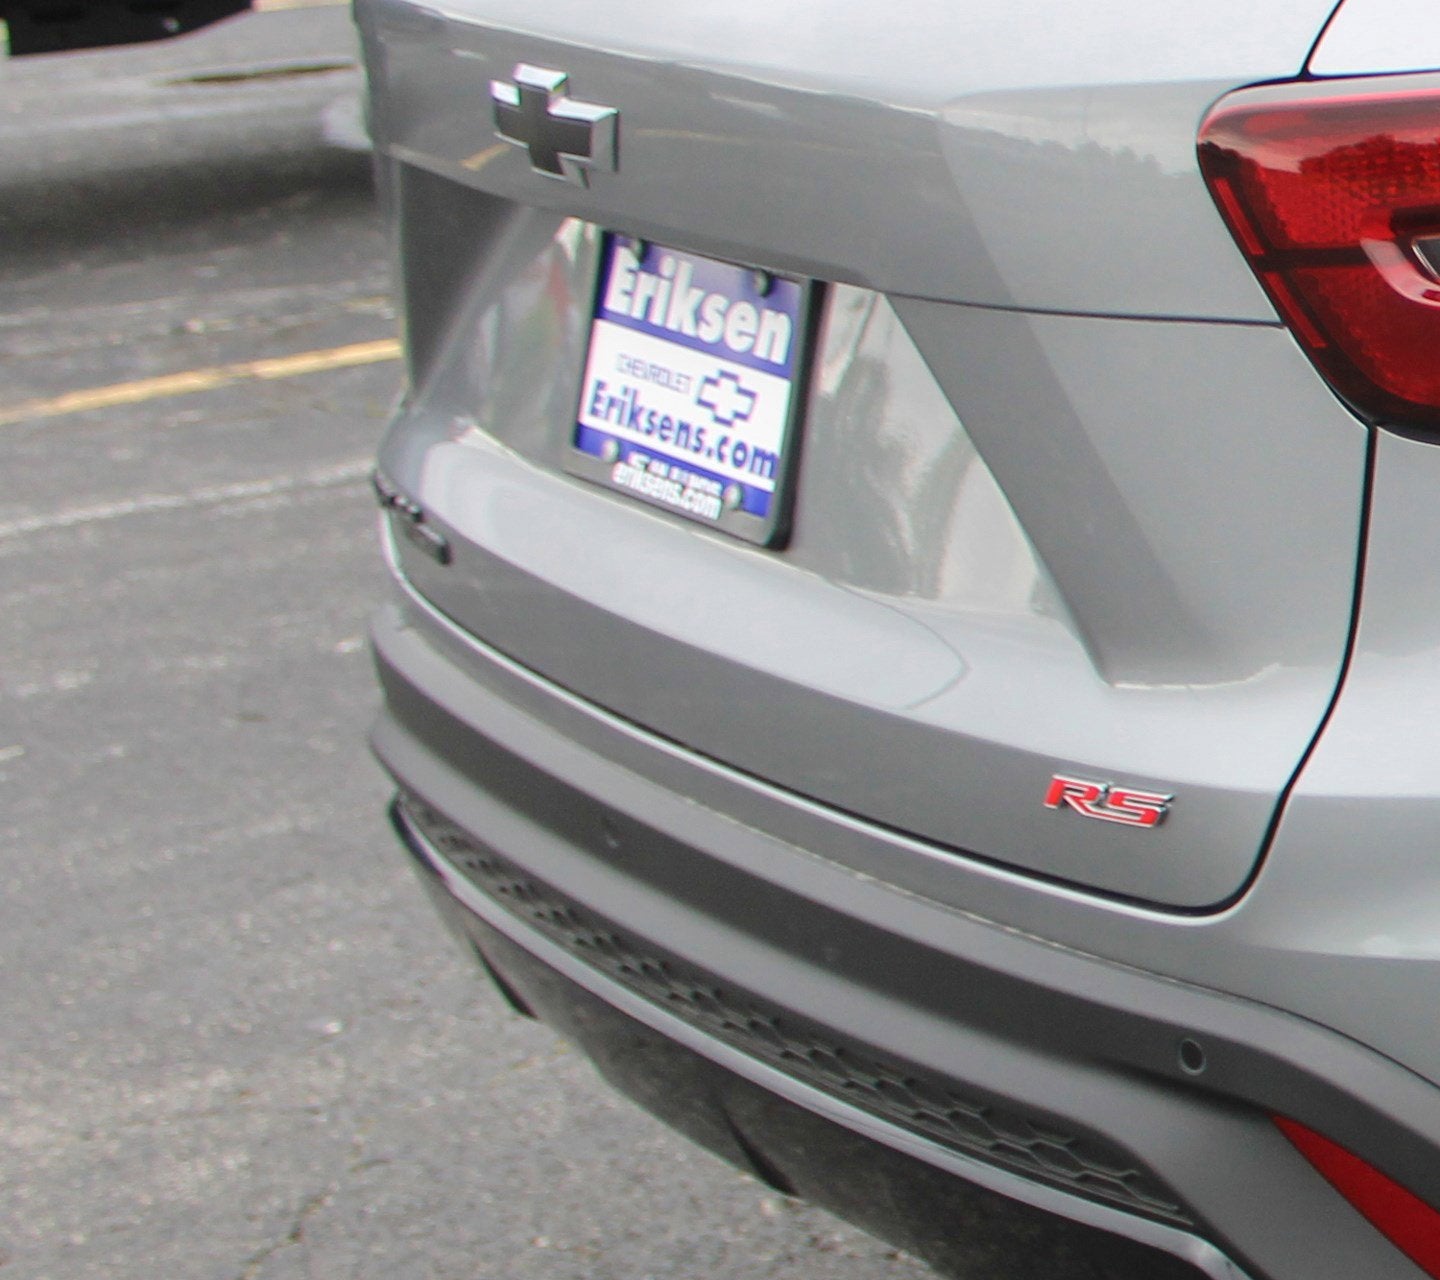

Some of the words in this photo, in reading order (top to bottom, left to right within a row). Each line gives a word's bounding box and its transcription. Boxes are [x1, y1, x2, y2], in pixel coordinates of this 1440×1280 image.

[604, 244, 793, 366] Eriksen
[587, 379, 779, 480] Eriksens.com
[1043, 773, 1178, 829] RS
